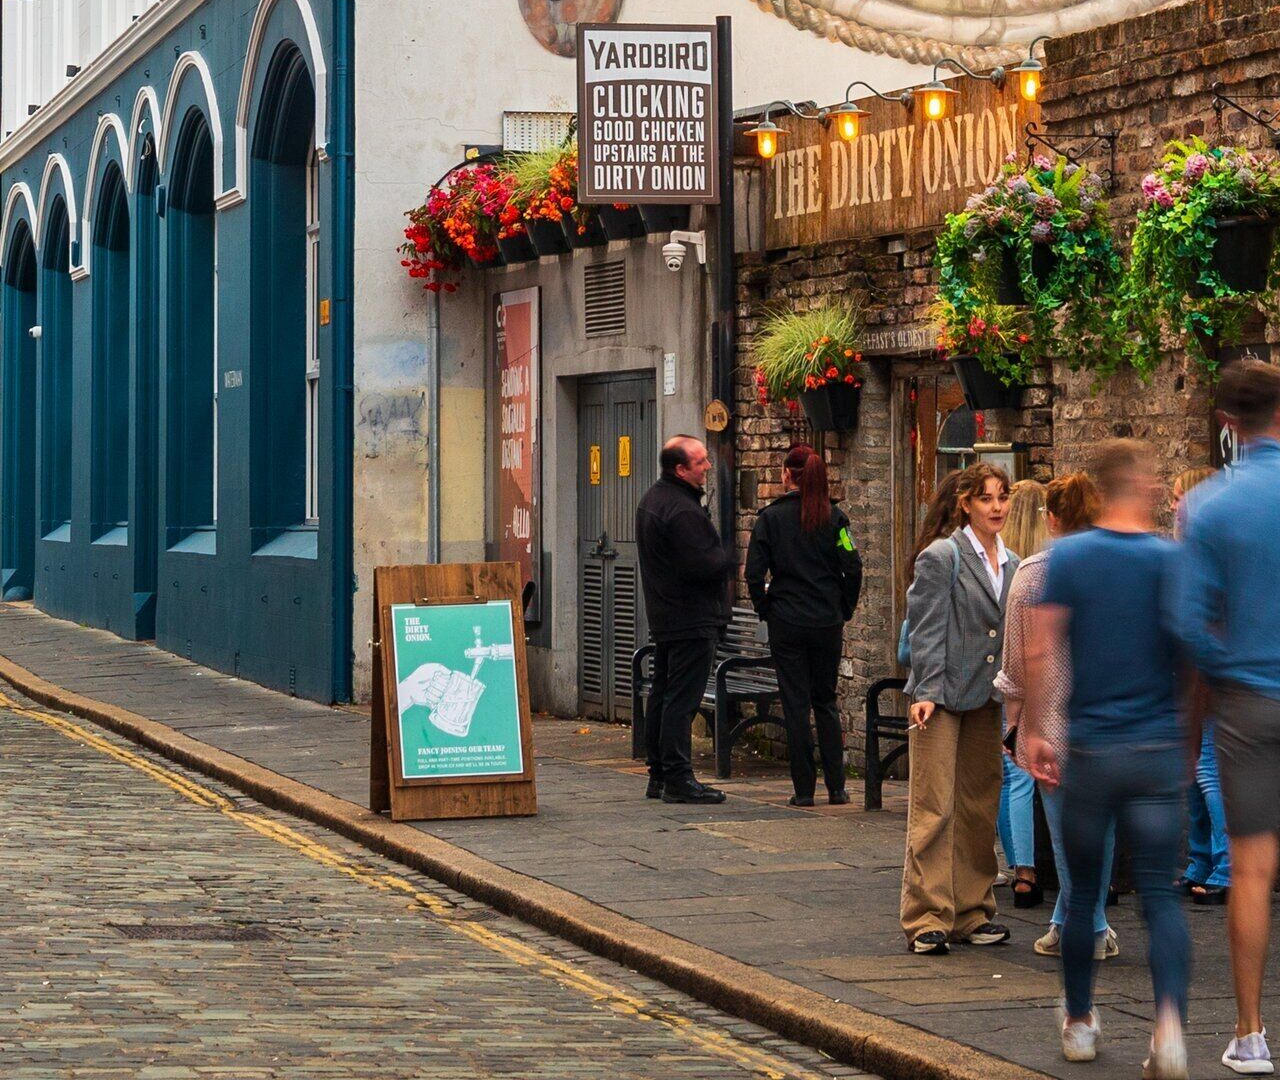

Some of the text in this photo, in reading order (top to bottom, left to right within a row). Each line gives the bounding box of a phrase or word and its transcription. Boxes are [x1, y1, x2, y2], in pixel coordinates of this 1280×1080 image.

[588, 39, 708, 71] YARDBIRD
[593, 84, 704, 118] CLUCKING
[593, 120, 705, 142] GOOD CHICKEN
[594, 144, 705, 163] UPSTAIRS AT THE
[771, 104, 1019, 220] THE DIRTY ONION
[594, 165, 706, 190] DIRTY ONION
[897, 328, 926, 348] OLDEST
[405, 625, 429, 634] DIRTY
[406, 633, 432, 642] ONION.
[417, 747, 439, 755] FANCY
[440, 746, 467, 755] JOINING
[468, 745, 483, 753] OUR
